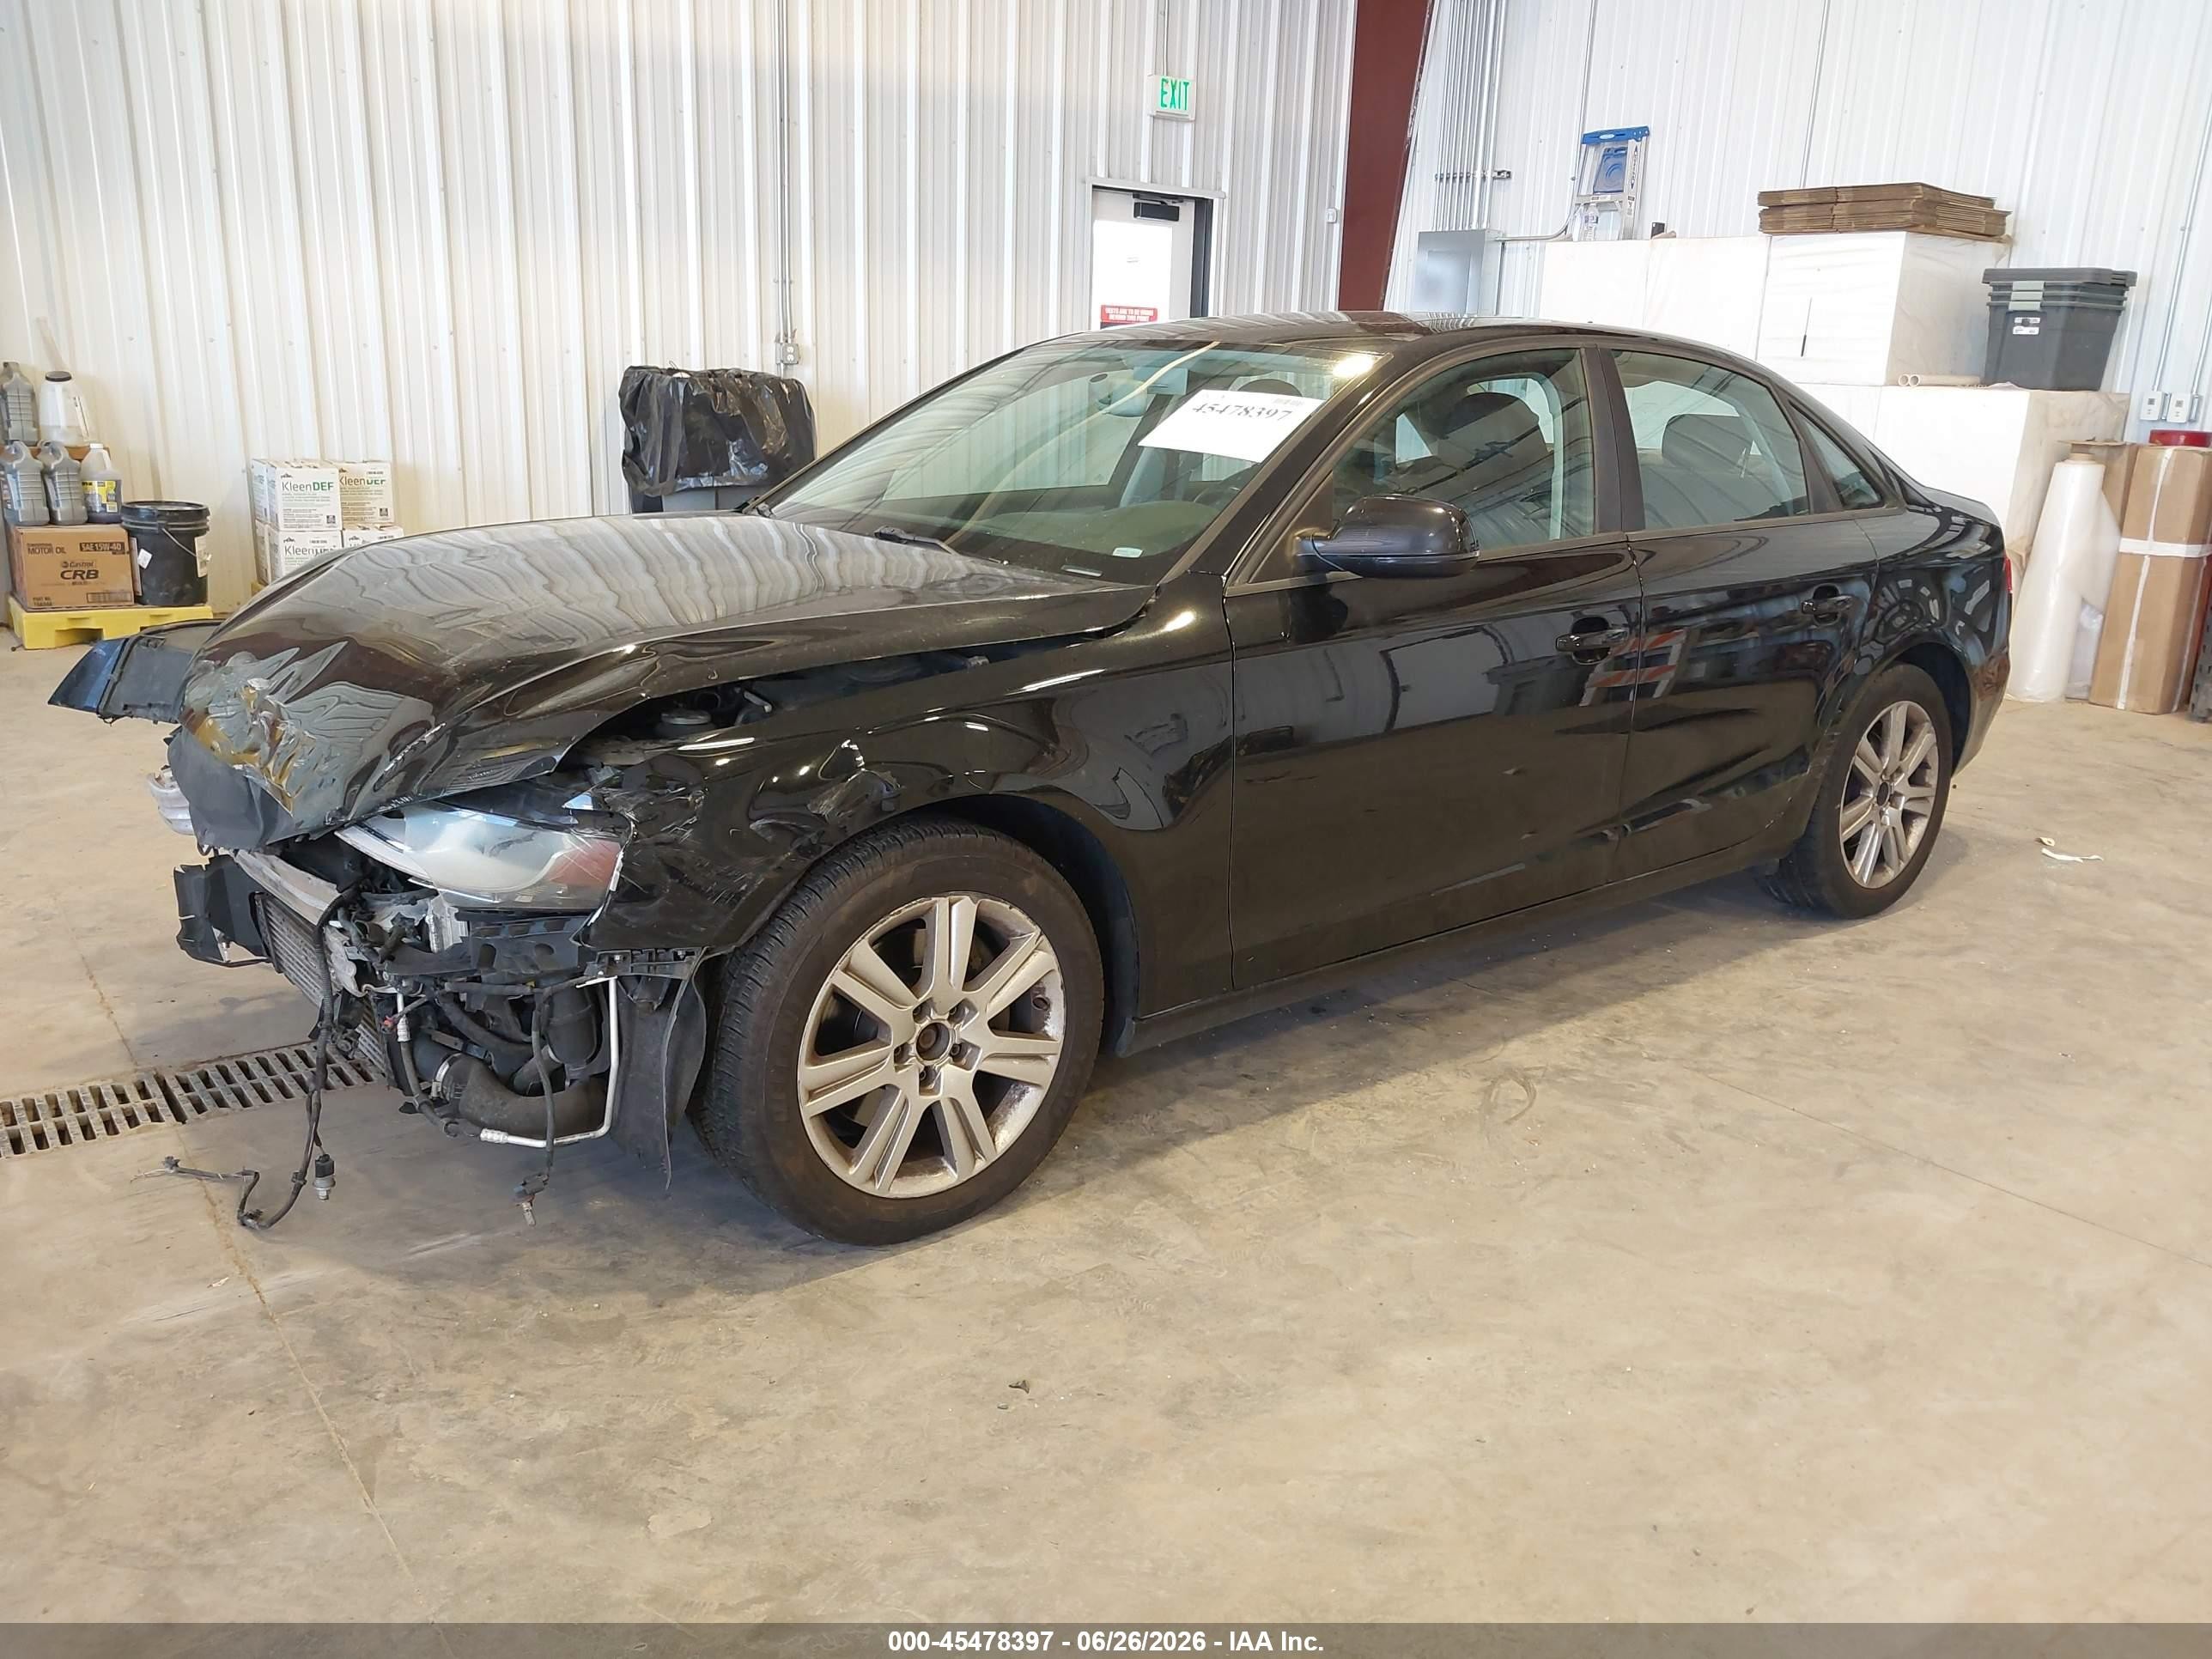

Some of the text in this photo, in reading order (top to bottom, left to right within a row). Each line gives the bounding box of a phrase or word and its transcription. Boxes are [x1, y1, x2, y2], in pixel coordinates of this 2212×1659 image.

[1161, 77, 1189, 110] EXIT
[1192, 402, 1293, 421] 45478397
[282, 481, 334, 491] KleenDEF
[27, 545, 53, 555] MOTOR
[95, 542, 121, 551] 15W-40
[60, 569, 99, 580] CRB
